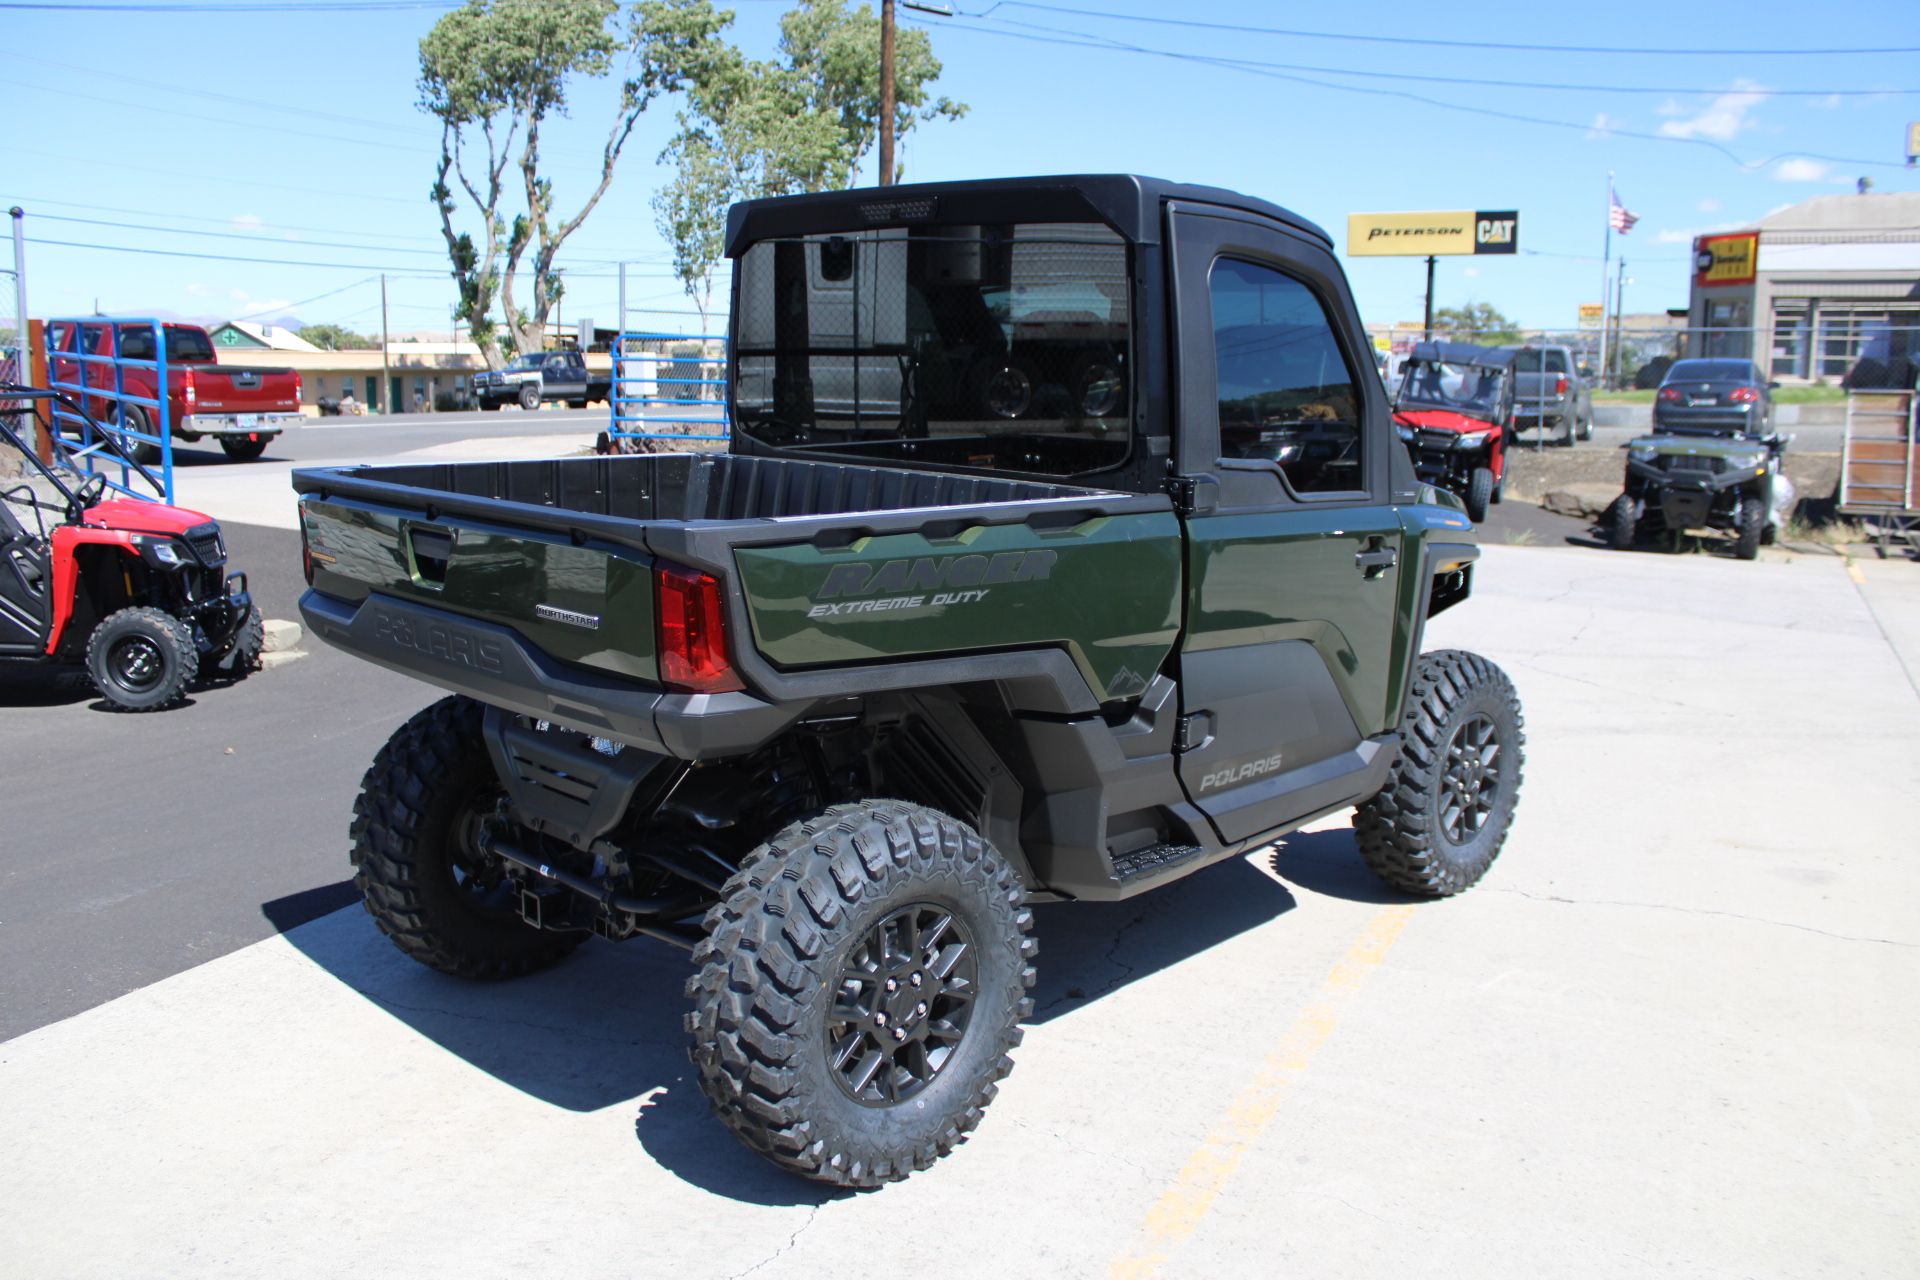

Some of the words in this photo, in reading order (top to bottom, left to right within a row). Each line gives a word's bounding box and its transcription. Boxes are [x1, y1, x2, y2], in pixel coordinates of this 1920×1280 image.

[1477, 220, 1515, 244] CAT
[816, 549, 1058, 598] RANGER
[537, 604, 596, 628] NORTHSTAR
[807, 596, 924, 618] EXTREME
[930, 589, 990, 606] DUTY
[375, 609, 502, 674] POLARIS
[1199, 754, 1283, 792] POLARIS
